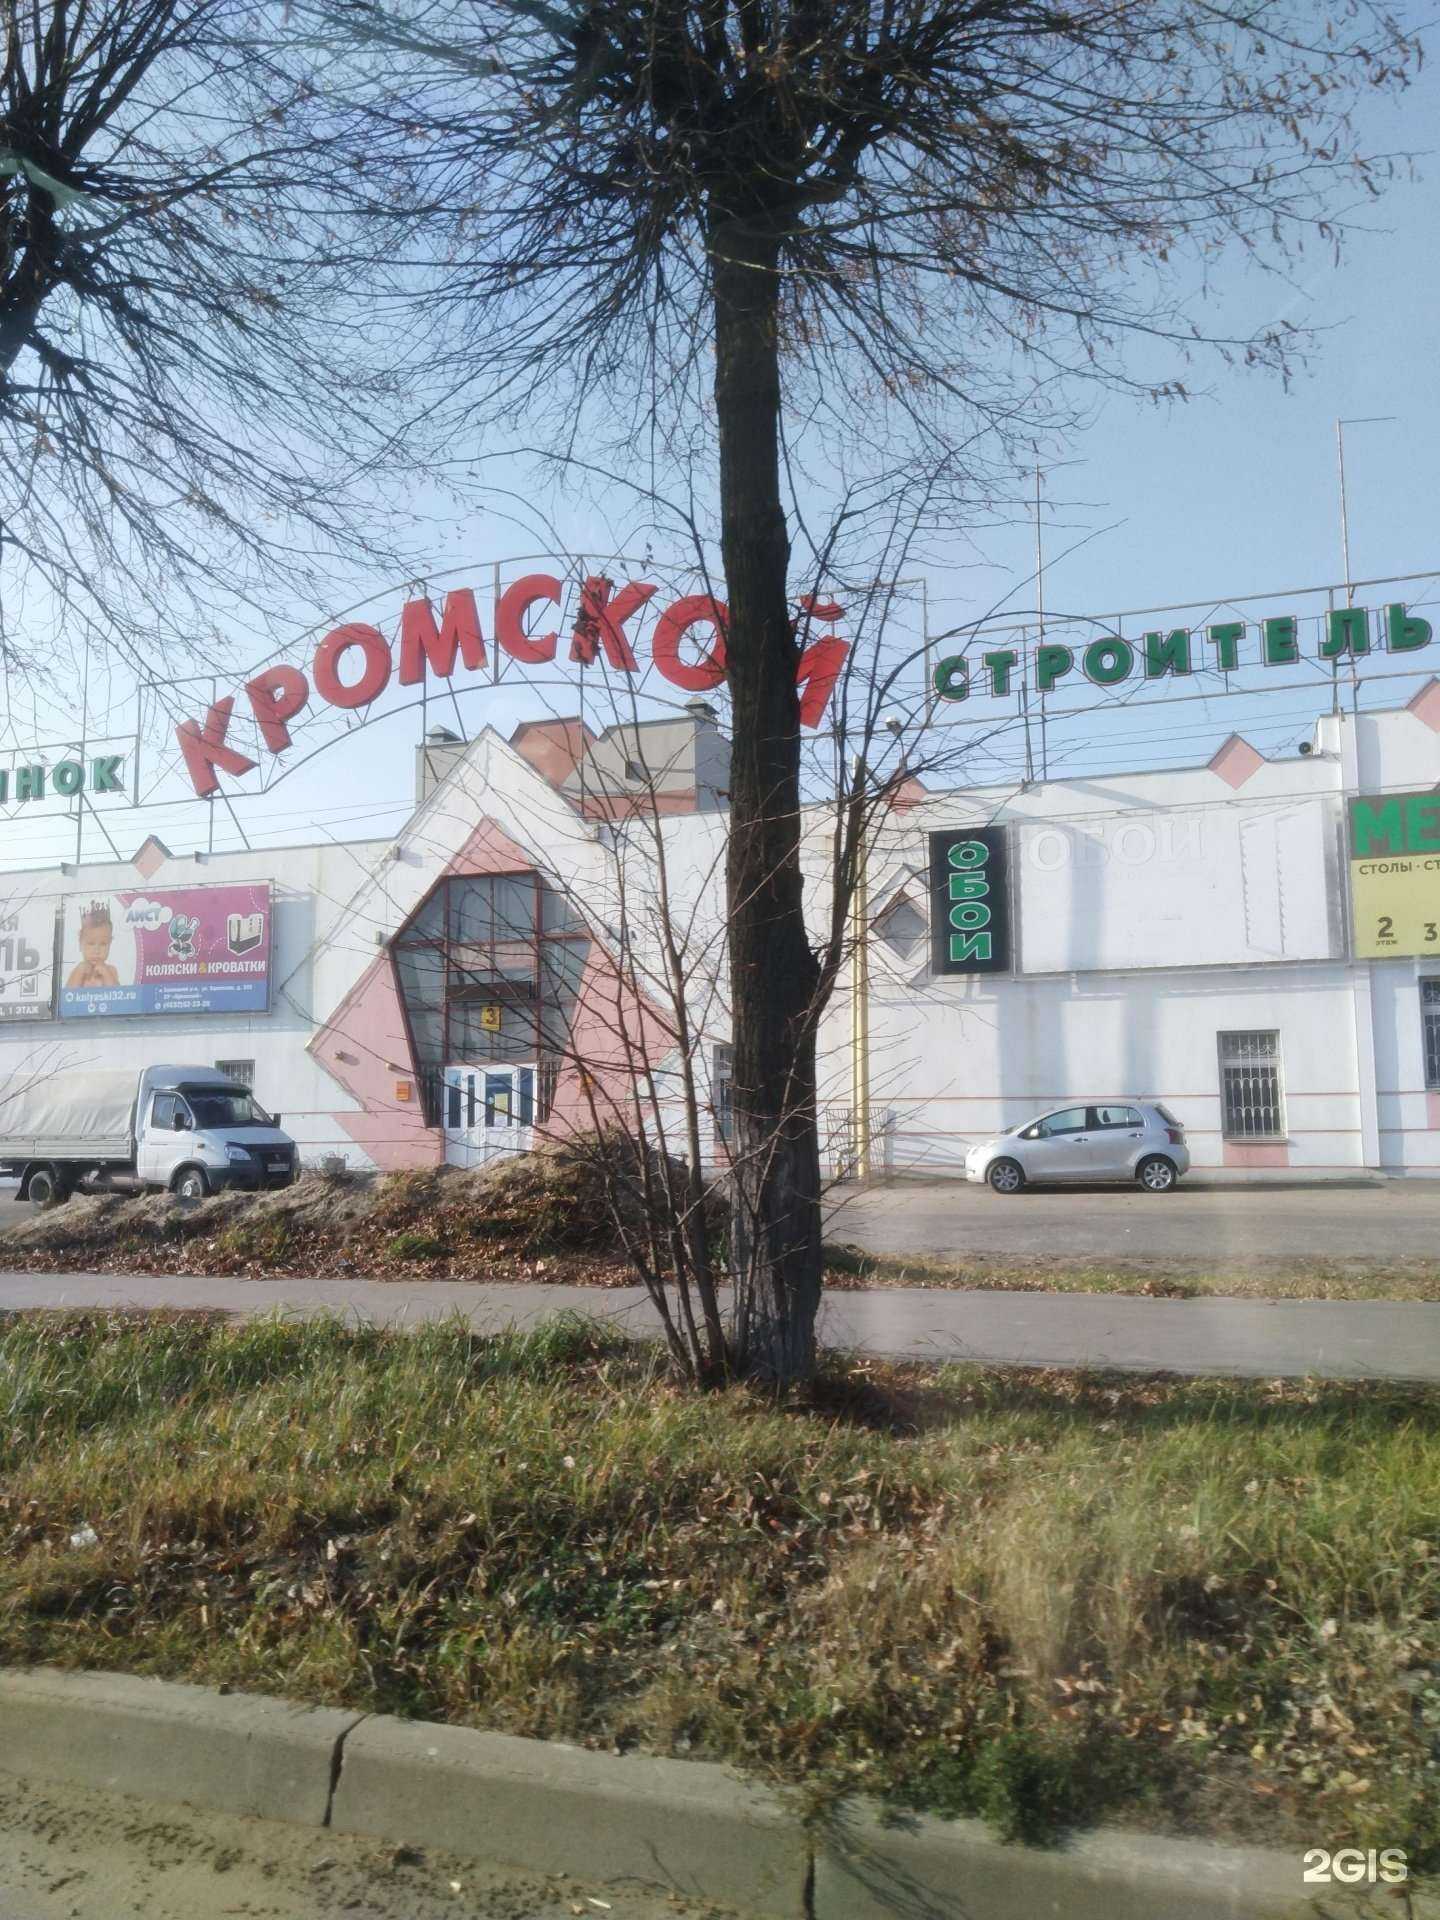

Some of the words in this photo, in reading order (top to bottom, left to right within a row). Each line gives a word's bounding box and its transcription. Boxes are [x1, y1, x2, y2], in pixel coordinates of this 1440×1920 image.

[932, 602, 1433, 703] СТРОИТЕЛЬ
[1353, 795, 1440, 855] МЕ
[1359, 862, 1412, 876] СТОЛЫ
[947, 840, 993, 963] ОБОИ
[126, 907, 161, 923] АИСТ
[1377, 916, 1394, 938] 2
[1424, 922, 1438, 942] 3
[146, 962, 198, 976] КОЛЯСКИ
[208, 960, 265, 974] КРОВАТКИ
[15, 1006, 39, 1015] ЭТАЖ
